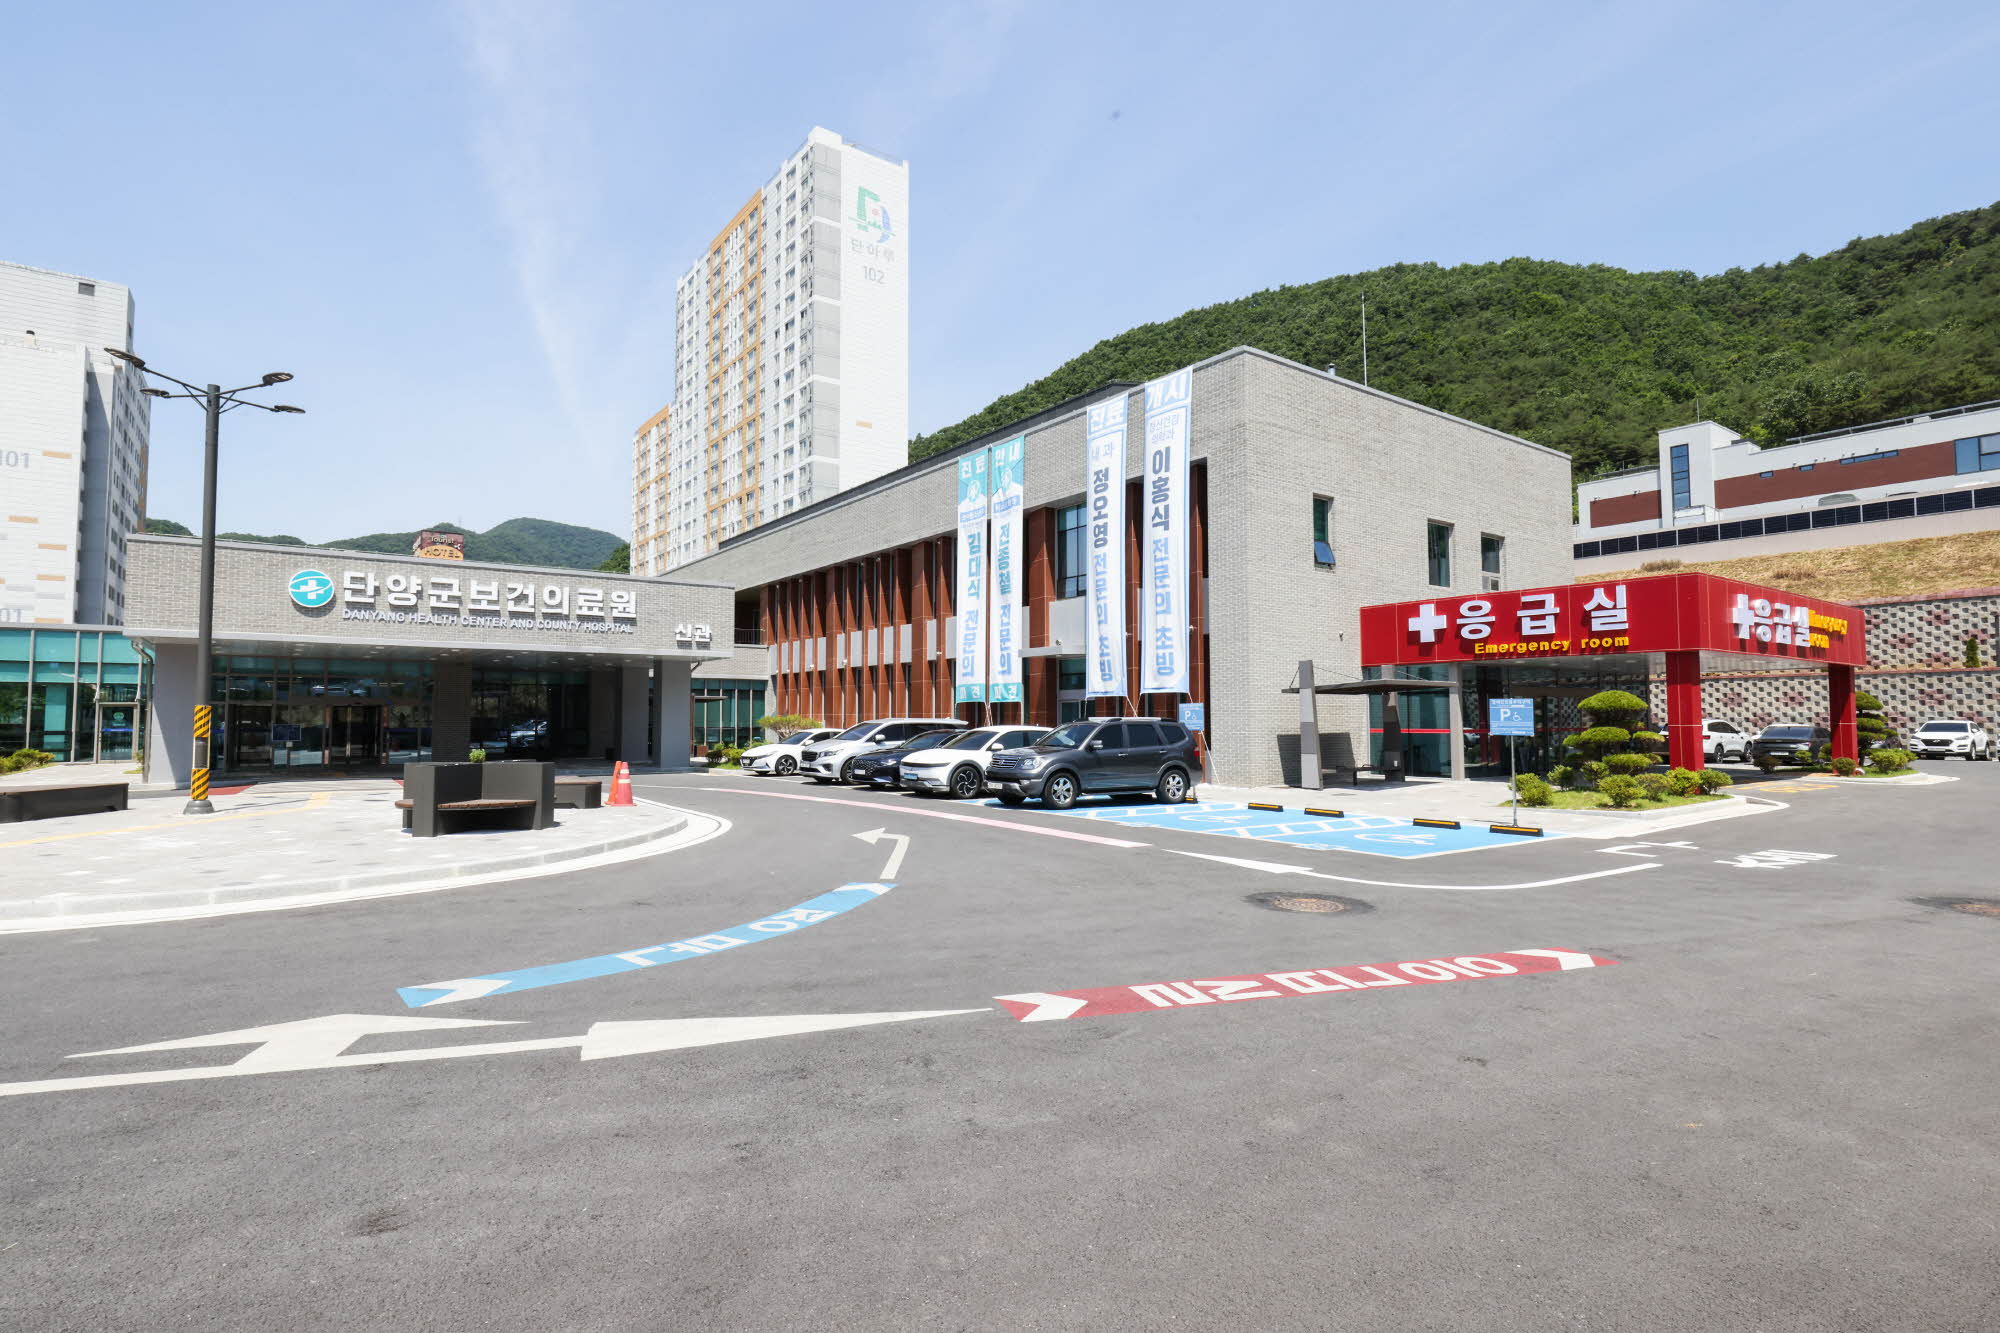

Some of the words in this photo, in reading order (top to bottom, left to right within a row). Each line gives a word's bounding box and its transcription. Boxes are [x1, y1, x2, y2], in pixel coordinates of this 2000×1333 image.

[863, 265, 886, 284] 102
[961, 455, 985, 479] 진료
[995, 441, 1021, 466] 안내
[1152, 446, 1171, 531] 이홍식
[424, 548, 461, 559] HOTEL
[967, 532, 981, 600] 김대식
[1152, 537, 1172, 614] 전문의
[343, 570, 638, 618] 단양군보건의료원
[1093, 552, 1108, 625] 전문의
[343, 609, 406, 624] DANYANG
[408, 612, 458, 626] HEALTH
[461, 615, 507, 628] CENTER
[510, 618, 534, 629] AND
[536, 619, 581, 632] COUNTY
[584, 622, 634, 634] HOSPITAL
[675, 623, 712, 642] 신관
[1456, 585, 1630, 642] 응급실
[1754, 599, 1811, 648] 응급실
[962, 608, 979, 677] 전문의
[998, 604, 1013, 675] 전문의
[1098, 635, 1113, 682] 초빙
[1155, 626, 1175, 676] 초빙
[1474, 639, 1571, 655] Emergency
[1581, 636, 1630, 649] room
[1185, 711, 1191, 721] P
[1500, 709, 1511, 721] P
[1129, 955, 1520, 1008] 응급실
